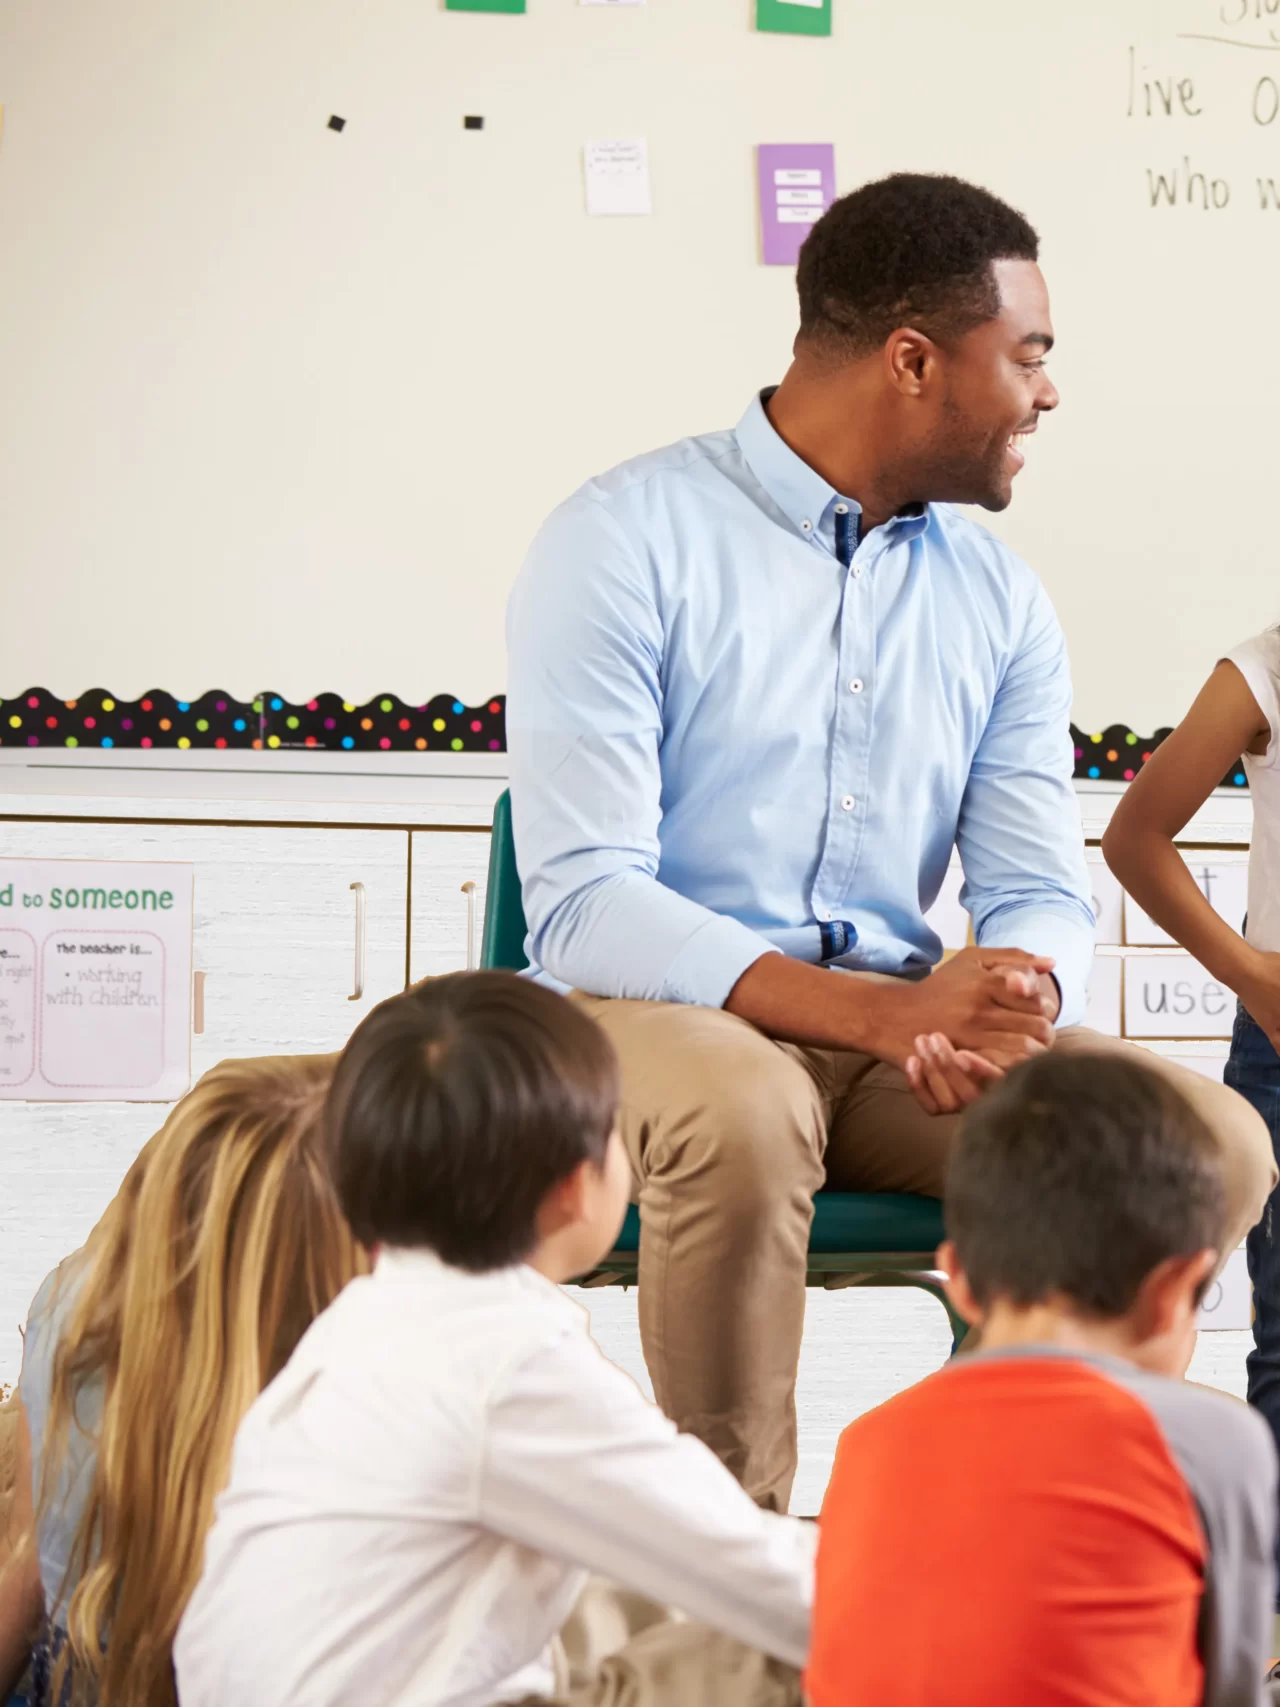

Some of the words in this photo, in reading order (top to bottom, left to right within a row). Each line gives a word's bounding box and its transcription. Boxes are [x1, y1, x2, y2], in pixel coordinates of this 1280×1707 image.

[1127, 45, 1203, 117] live
[1146, 155, 1231, 211] who
[23, 892, 44, 908] to
[49, 887, 174, 911] someone
[1143, 980, 1228, 1016] use
